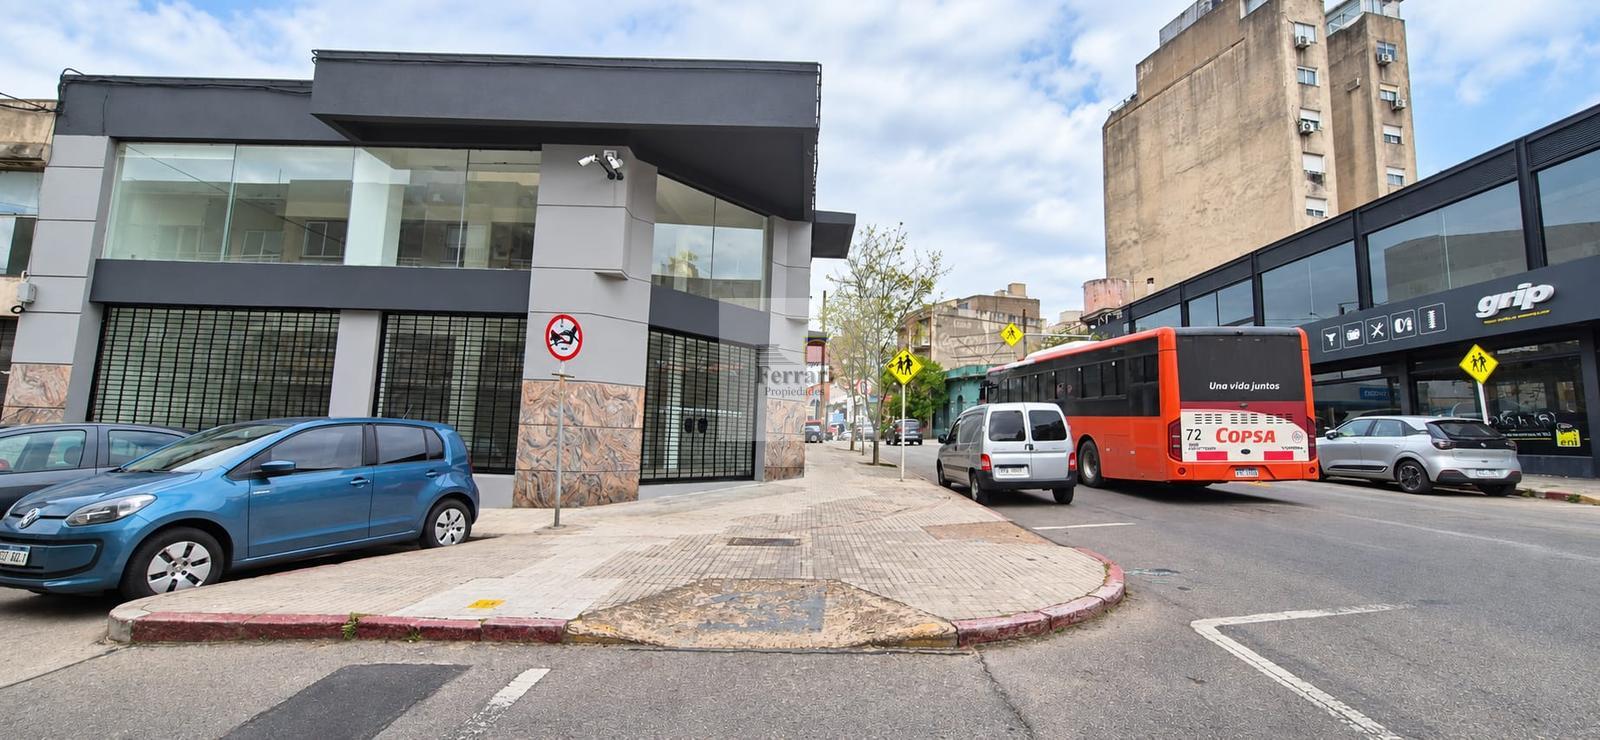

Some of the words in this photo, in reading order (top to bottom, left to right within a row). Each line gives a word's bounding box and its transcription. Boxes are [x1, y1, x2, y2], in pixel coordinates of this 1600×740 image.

[1475, 283, 1555, 318] grip
[1209, 381, 1228, 390] Una
[1229, 381, 1250, 390] vida
[1250, 381, 1280, 391] juntos
[1186, 428, 1202, 441] 72
[1560, 435, 1578, 447] eni
